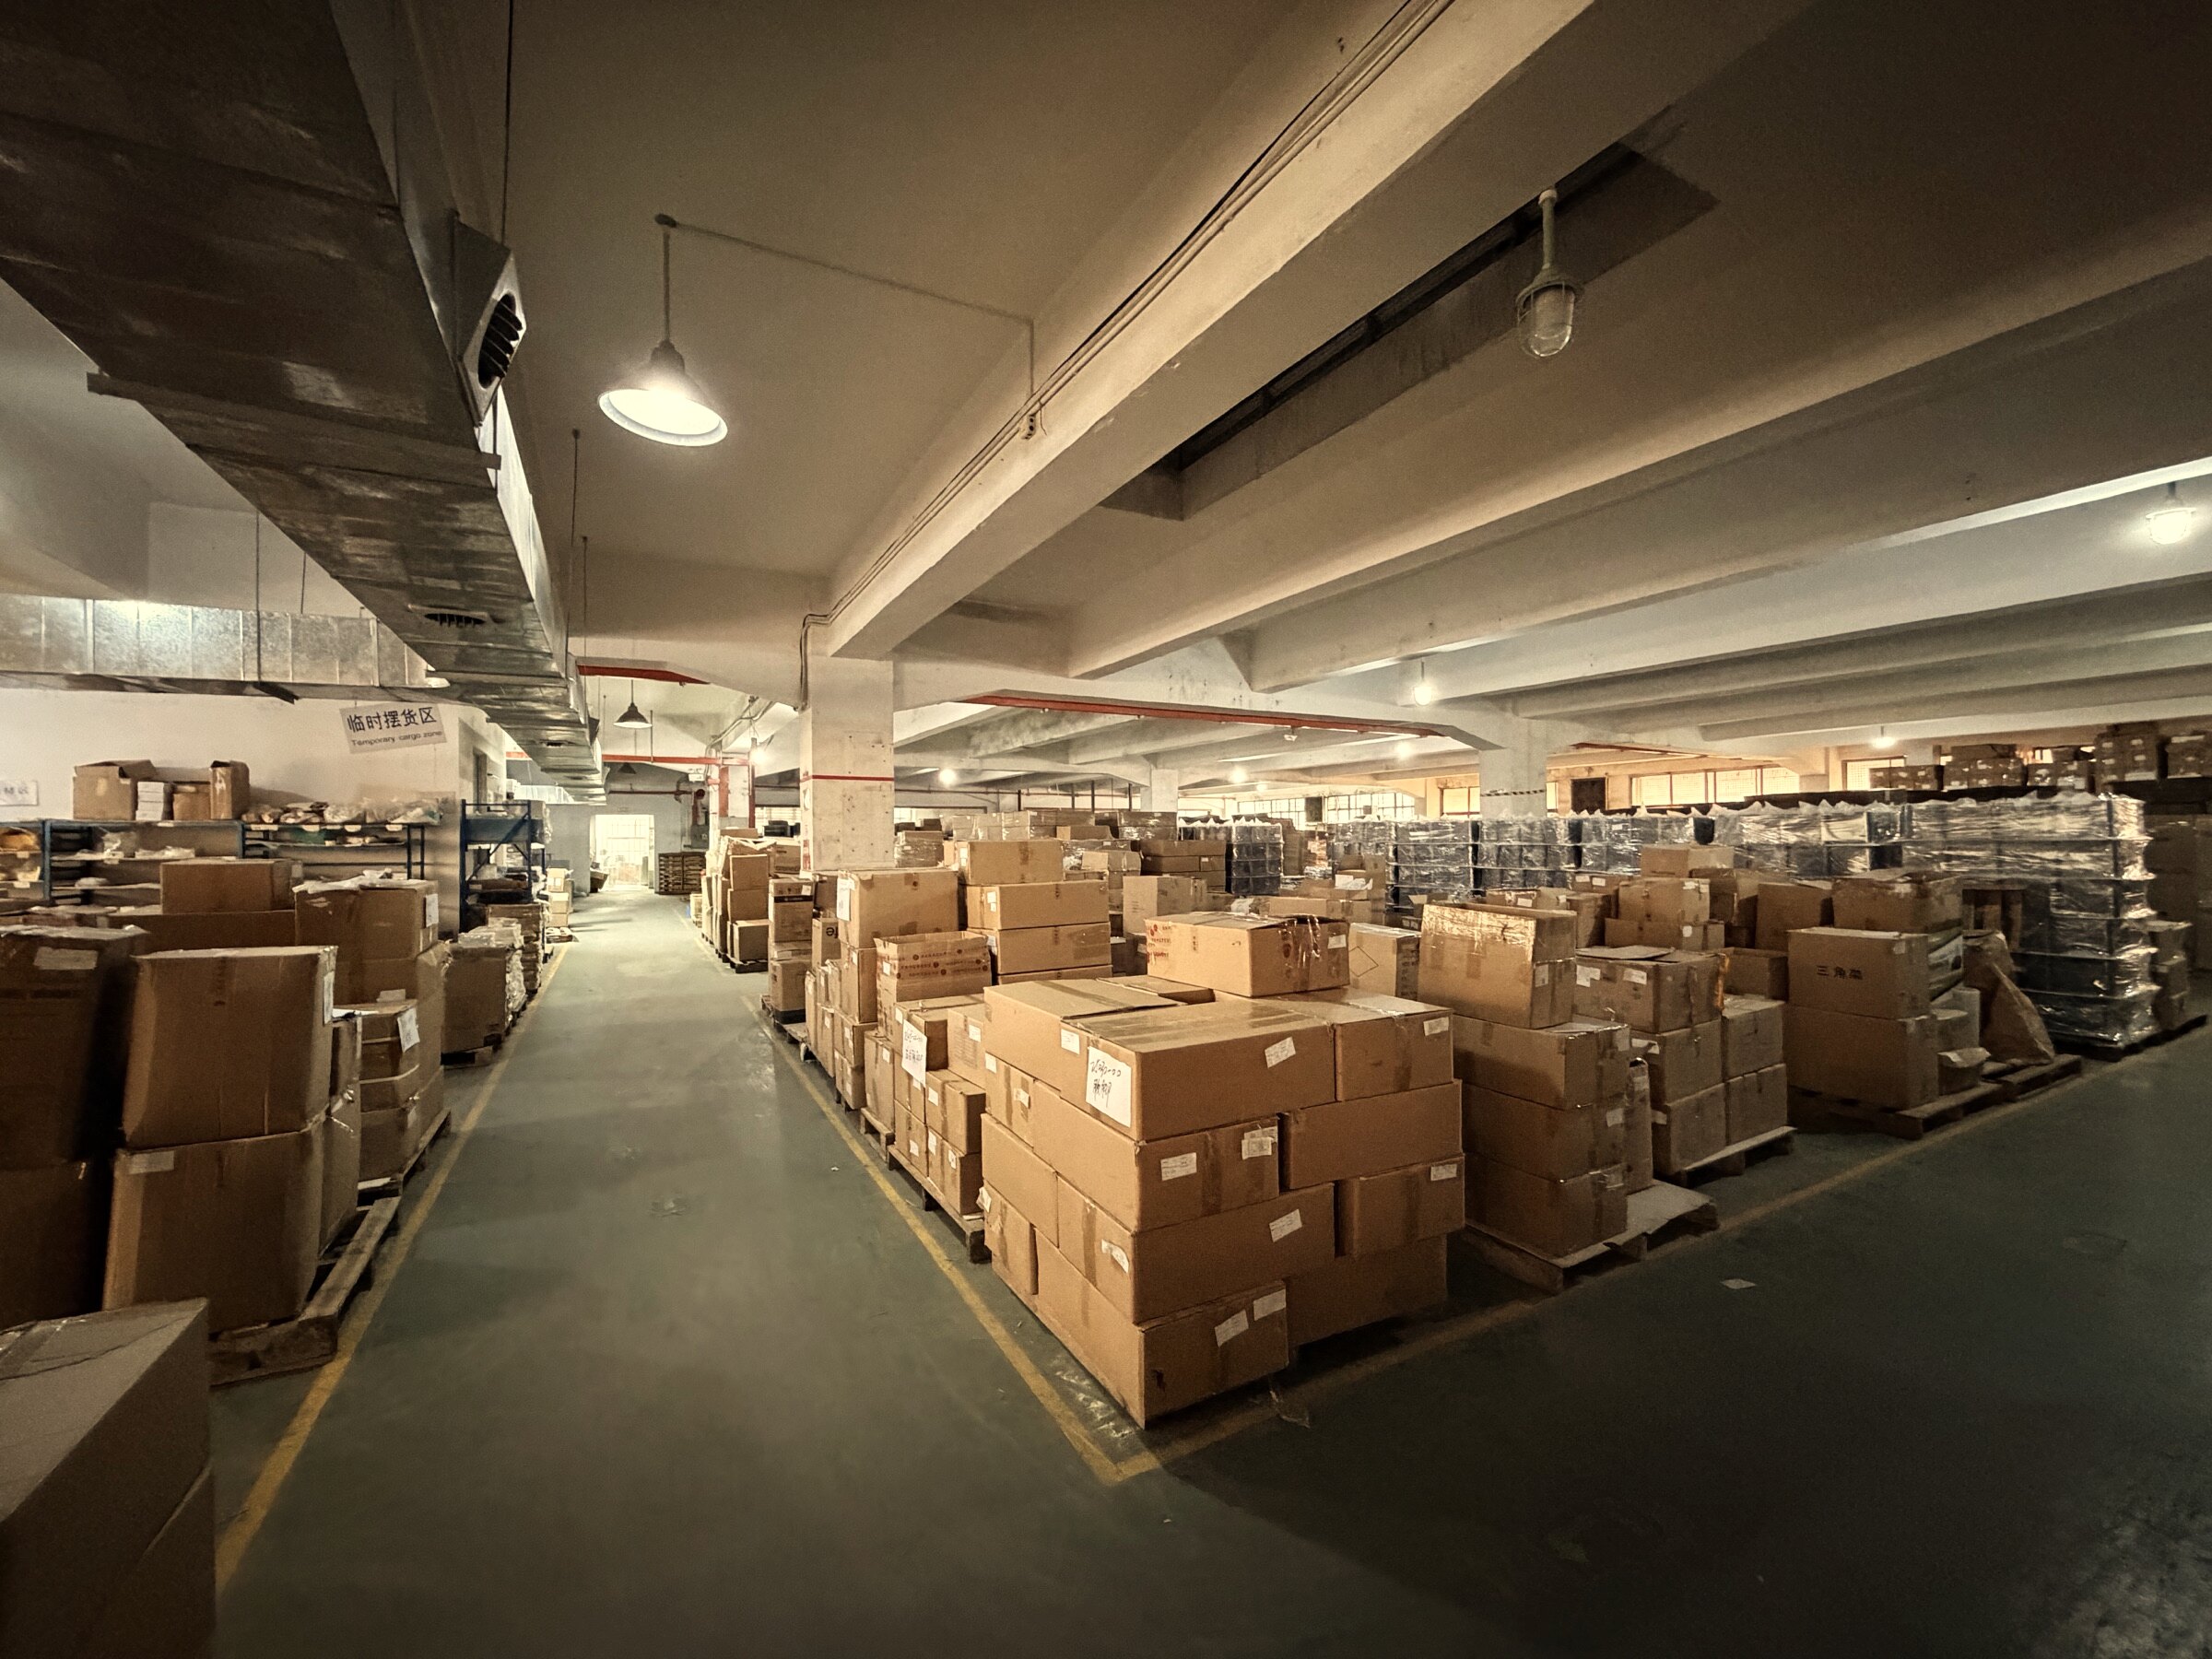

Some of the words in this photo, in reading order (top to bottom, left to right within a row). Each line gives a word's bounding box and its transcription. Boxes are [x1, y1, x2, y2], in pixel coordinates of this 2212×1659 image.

[347, 707, 437, 733] 临时摆货区
[351, 736, 395, 746] Temporary
[398, 733, 420, 741] cargo
